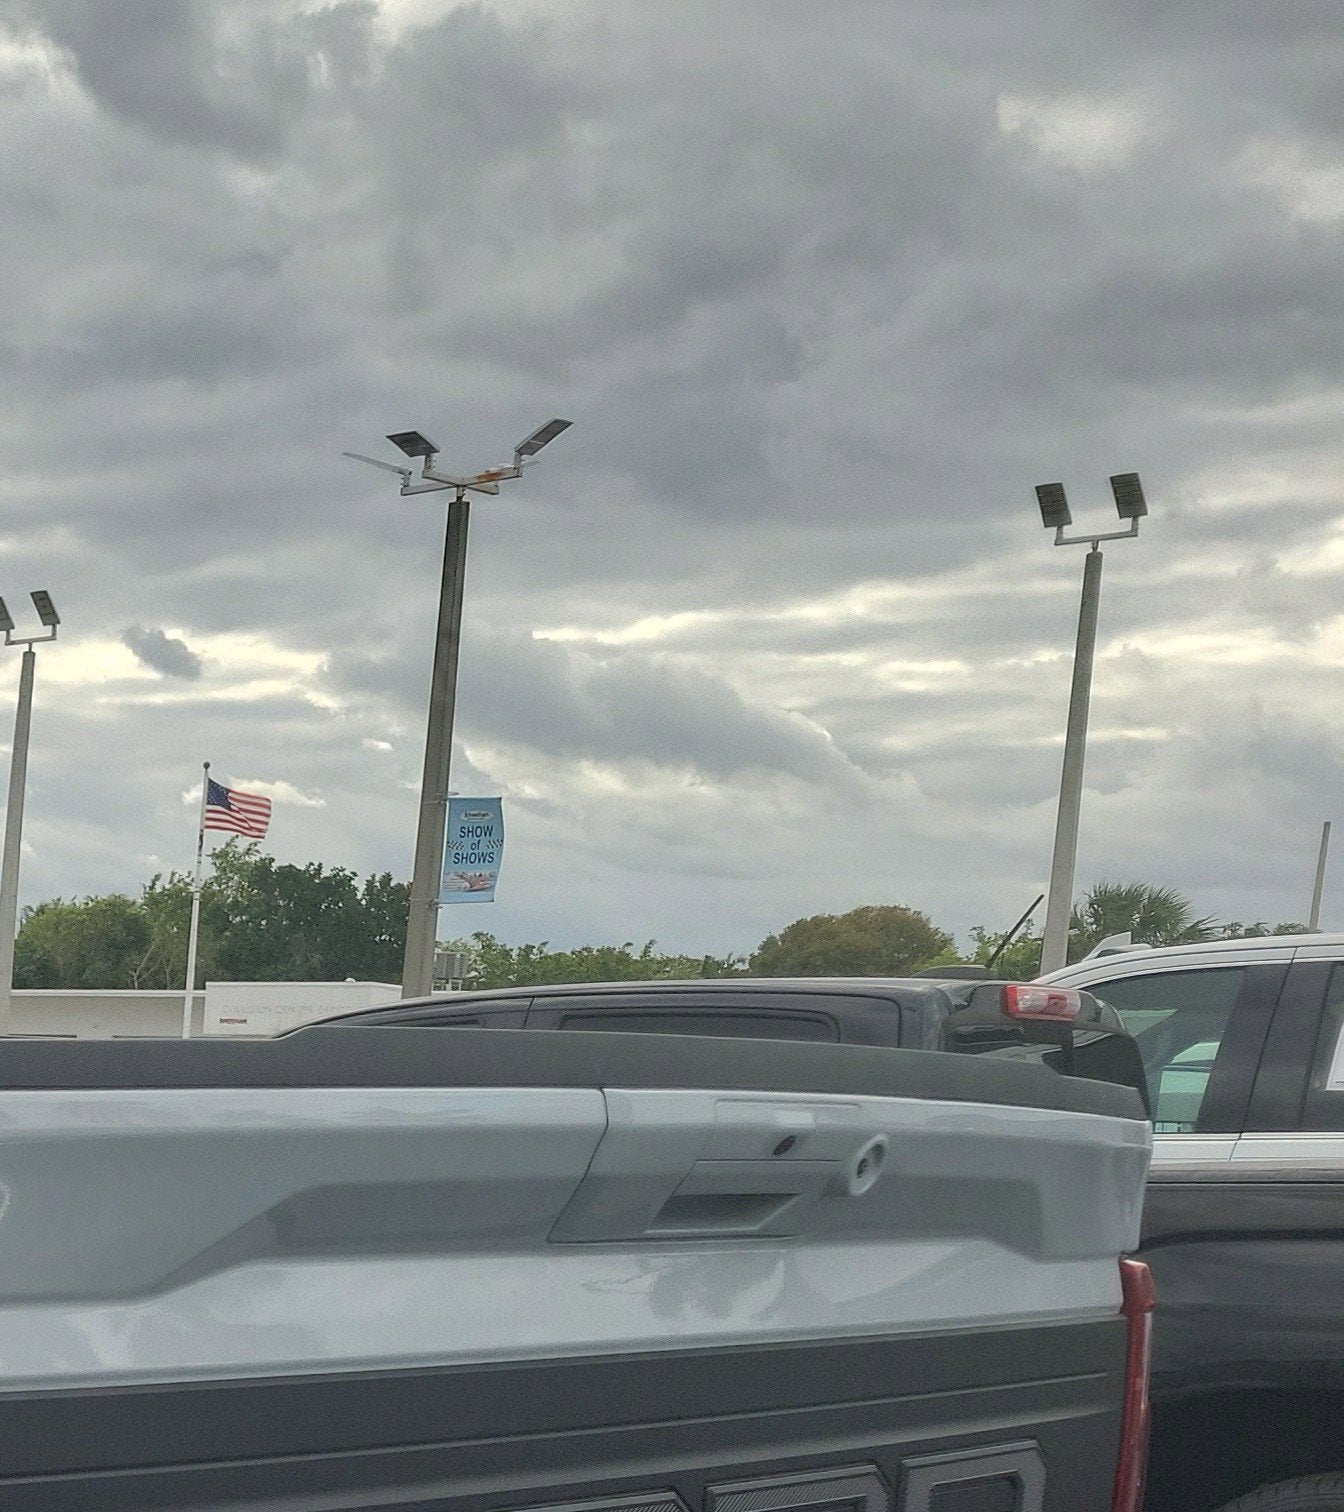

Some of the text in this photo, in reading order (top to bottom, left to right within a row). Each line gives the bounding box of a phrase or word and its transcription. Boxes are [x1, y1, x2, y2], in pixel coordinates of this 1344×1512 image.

[459, 825, 494, 839] SHOW
[470, 840, 481, 852] of
[453, 852, 495, 865] SHOWS
